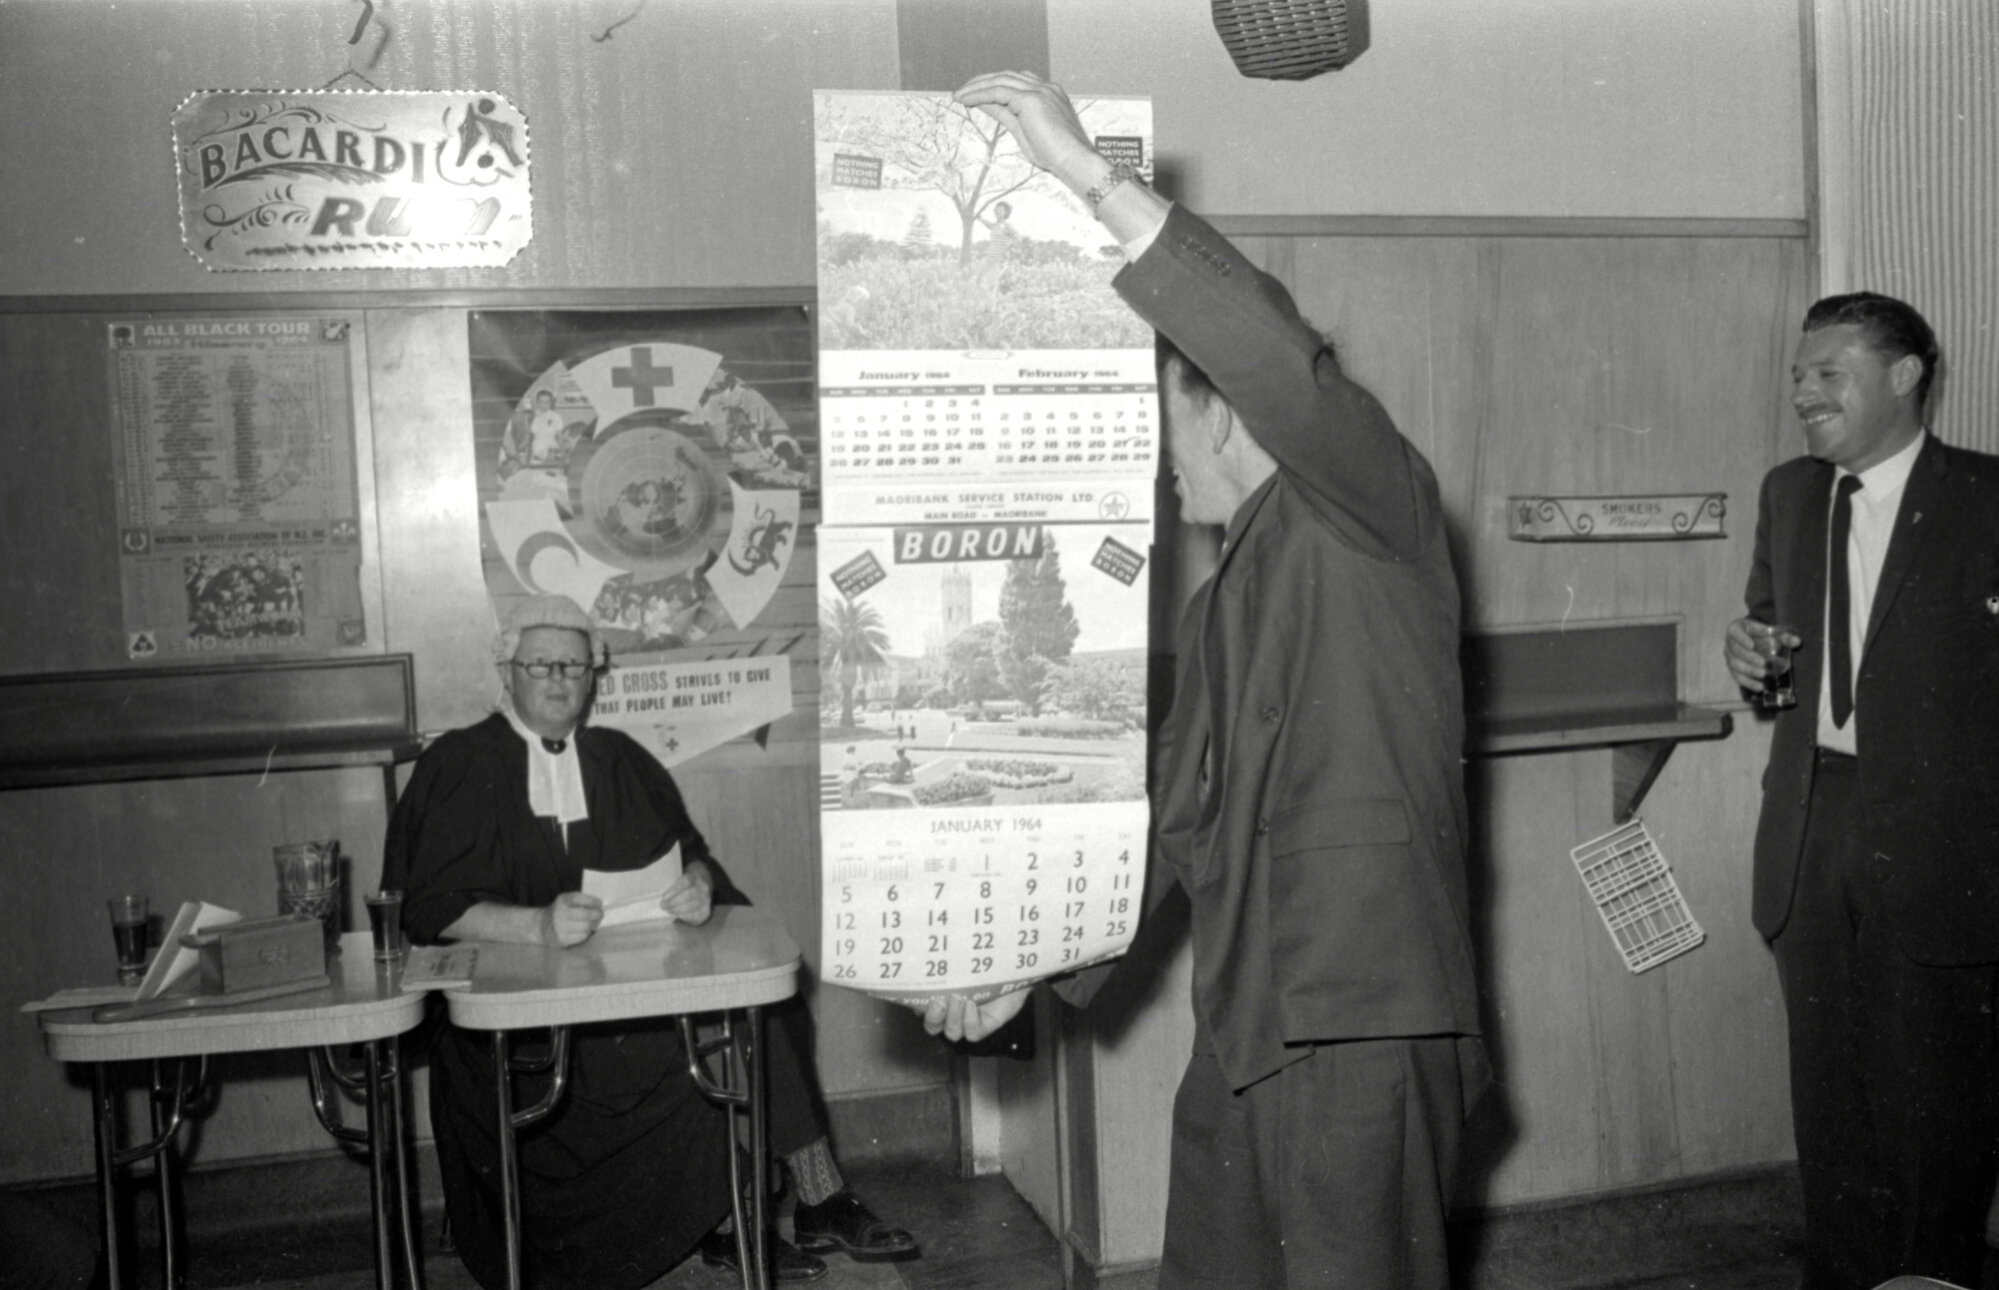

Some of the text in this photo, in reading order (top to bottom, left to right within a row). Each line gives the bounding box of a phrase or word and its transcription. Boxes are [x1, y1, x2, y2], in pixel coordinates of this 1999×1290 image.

[200, 126, 426, 189] BACARDI
[1099, 149, 1140, 157] MATCHES
[837, 158, 880, 170] NOTHING
[1107, 157, 1140, 165] ORON
[837, 167, 879, 177] MATCHES
[835, 175, 877, 186] BORON
[143, 321, 311, 337] ALL BLACK TOUR
[858, 371, 920, 380] January
[1018, 369, 1088, 379] February
[925, 400, 933, 408] 2
[949, 399, 957, 407] 3
[833, 416, 841, 424] 5
[926, 414, 935, 422] 9
[971, 413, 981, 421] 11
[1000, 413, 1009, 421] 2
[1024, 412, 1032, 420] 3
[1046, 412, 1055, 420] 4
[1070, 412, 1078, 420] 5
[1116, 411, 1124, 419] 7
[854, 430, 868, 438] 13
[900, 429, 913, 437] 15
[947, 428, 960, 436] 17
[1001, 427, 1010, 435] 9
[1021, 427, 1035, 435] 10
[1067, 426, 1081, 434] 12
[1091, 426, 1104, 434] 13
[1136, 425, 1149, 433] 15
[831, 445, 845, 453] 19
[878, 444, 891, 452] 21
[922, 443, 939, 451] 23
[968, 442, 985, 450] 25
[1021, 441, 1035, 449] 17
[1045, 441, 1058, 449] 18
[1088, 440, 1106, 448] 20
[1113, 440, 1130, 448] 21
[1133, 439, 1151, 447] 22
[830, 459, 847, 467] 26
[876, 458, 894, 466] 28
[922, 457, 939, 465] 30
[996, 455, 1013, 463] 23
[1019, 455, 1036, 463] 24
[1065, 454, 1082, 462] 26
[1088, 454, 1105, 462] 27
[875, 493, 1093, 505] MAORIBANK SERVICE STATION LTD
[952, 511, 976, 519] ROAD
[1602, 504, 1662, 515] SMOKERS
[902, 527, 1037, 560] BORON
[1103, 543, 1140, 566] NOTHING
[836, 556, 872, 581] NOTHING
[840, 564, 876, 590] MATCHES
[186, 635, 218, 651] NO
[623, 671, 668, 694] CROSS
[675, 673, 721, 689] STRIVES
[728, 672, 741, 685] TO
[747, 668, 771, 683] GIVE
[594, 691, 732, 715] THAT PEOPLE MAY LIVE!
[931, 818, 1042, 833] JANUARY 1964
[984, 849, 1129, 872] 1 2 3 4
[842, 874, 1130, 903] 5 6 7 8 9 10 11
[836, 897, 1128, 930] 12 13 14 15 16 17 18
[836, 921, 1127, 956] 19 20 21 22 23 24 25
[833, 949, 1080, 980] 26 27 28 29 30 31
